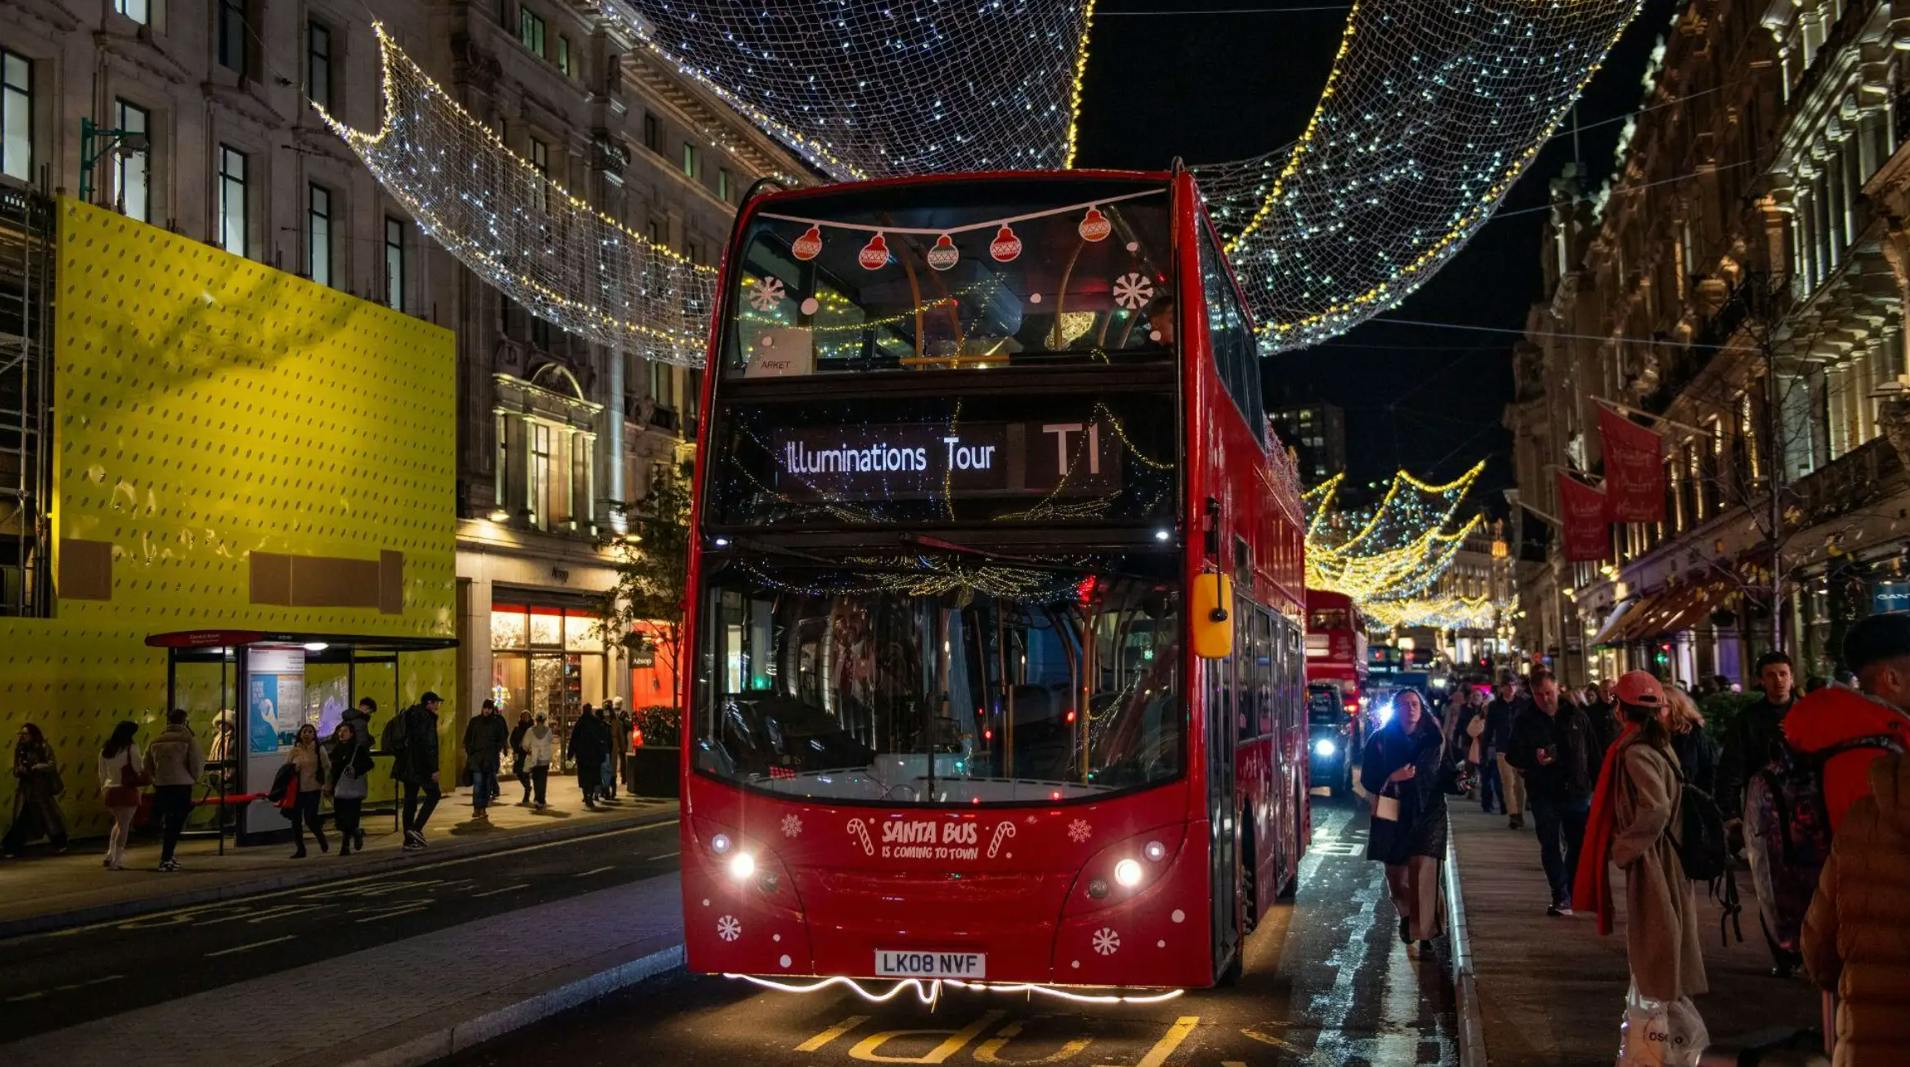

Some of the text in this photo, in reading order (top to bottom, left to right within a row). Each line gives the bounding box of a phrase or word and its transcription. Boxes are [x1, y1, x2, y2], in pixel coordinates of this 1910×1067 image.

[786, 436, 996, 473] Illuminations Tour
[1042, 422, 1099, 476] T1
[882, 820, 978, 845] SANTA BUS
[881, 846, 979, 860] IS COMING TO TOWN
[883, 953, 978, 973] LK08 NVF
